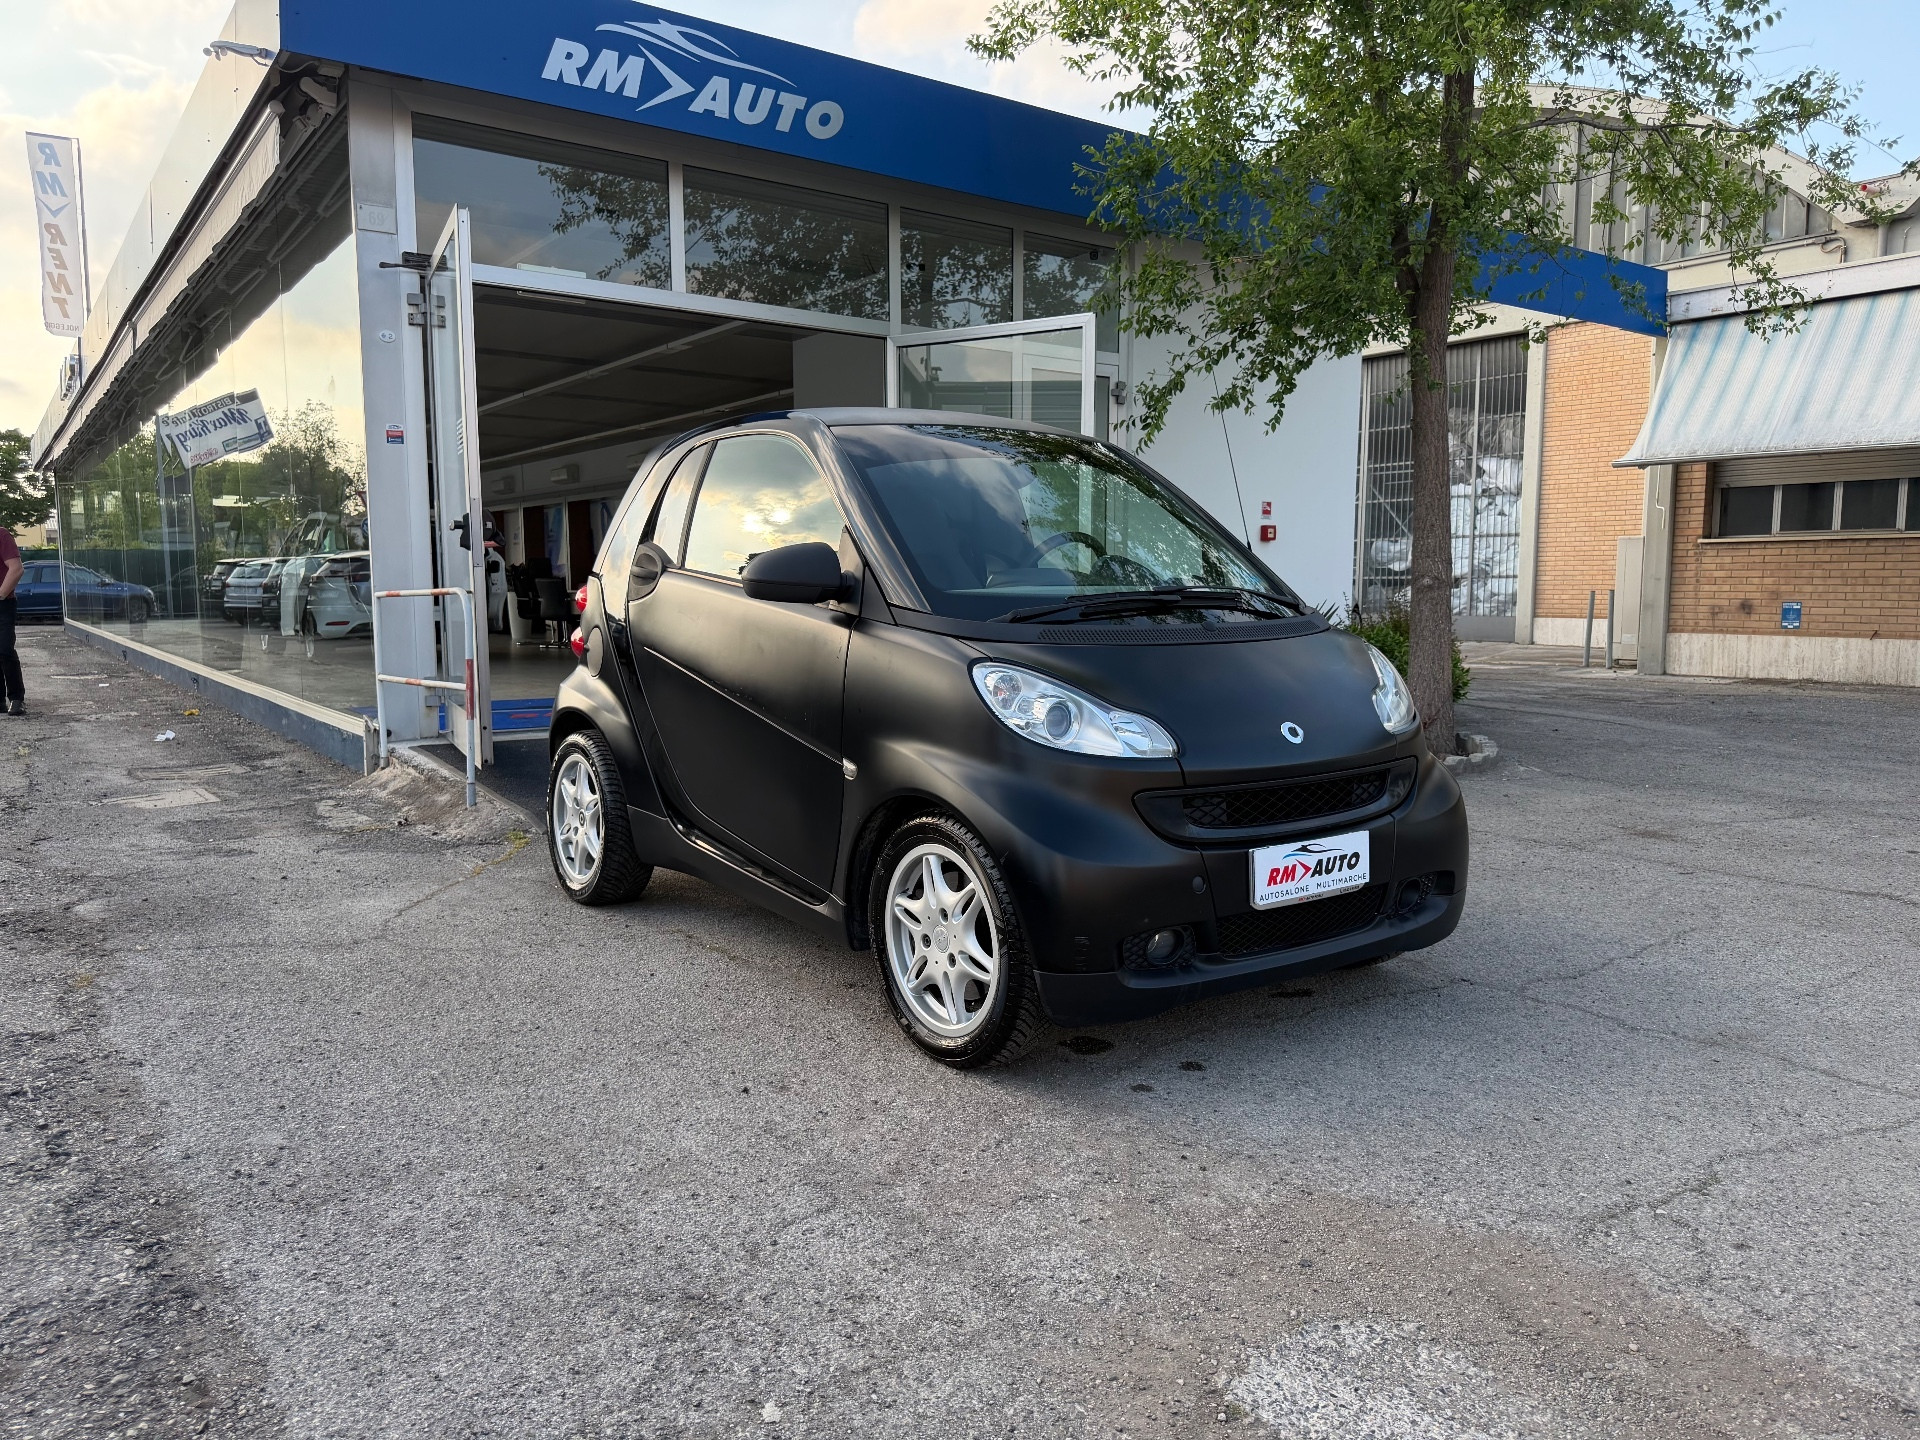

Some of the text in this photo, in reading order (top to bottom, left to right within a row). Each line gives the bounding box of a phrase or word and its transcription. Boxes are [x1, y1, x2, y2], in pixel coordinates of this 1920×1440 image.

[541, 37, 845, 140] RM AUTO
[1267, 852, 1361, 887] RM AUTO
[1259, 884, 1310, 902] AUTOSALONE
[1316, 873, 1367, 890] MULTIMARCHE
